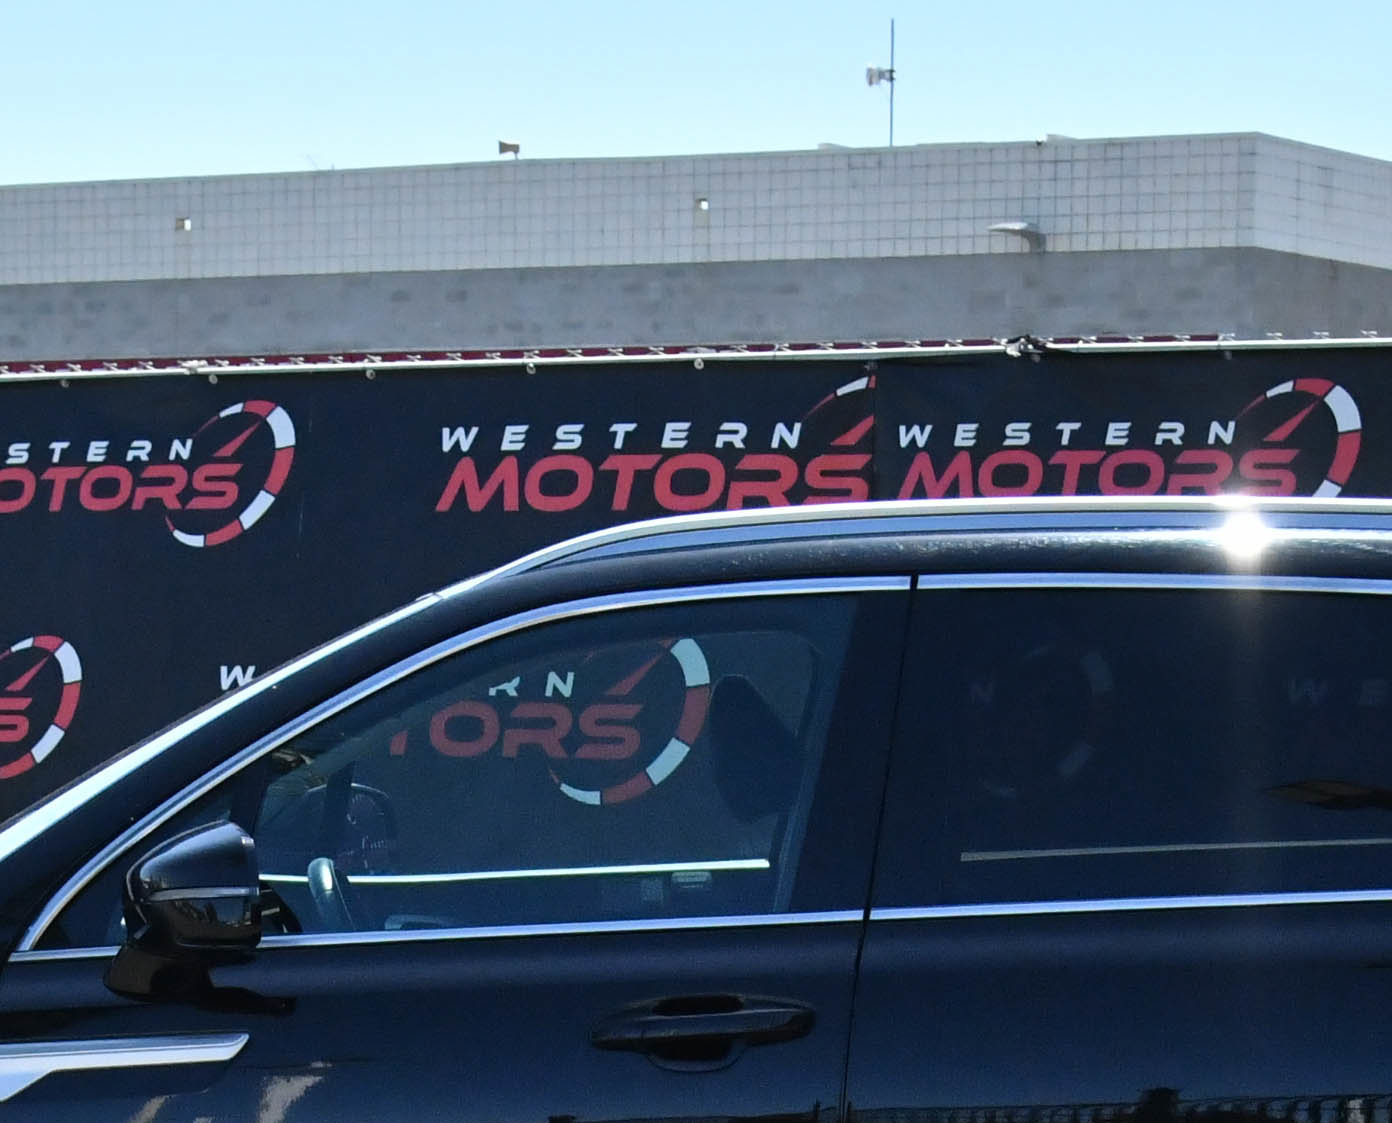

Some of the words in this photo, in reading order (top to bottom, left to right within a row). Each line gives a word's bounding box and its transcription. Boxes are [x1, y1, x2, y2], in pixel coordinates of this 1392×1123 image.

[441, 421, 802, 453] WESTERN
[898, 420, 1236, 448] WESTERN
[435, 452, 873, 512] MOTORS
[897, 448, 1298, 498] MOTORS
